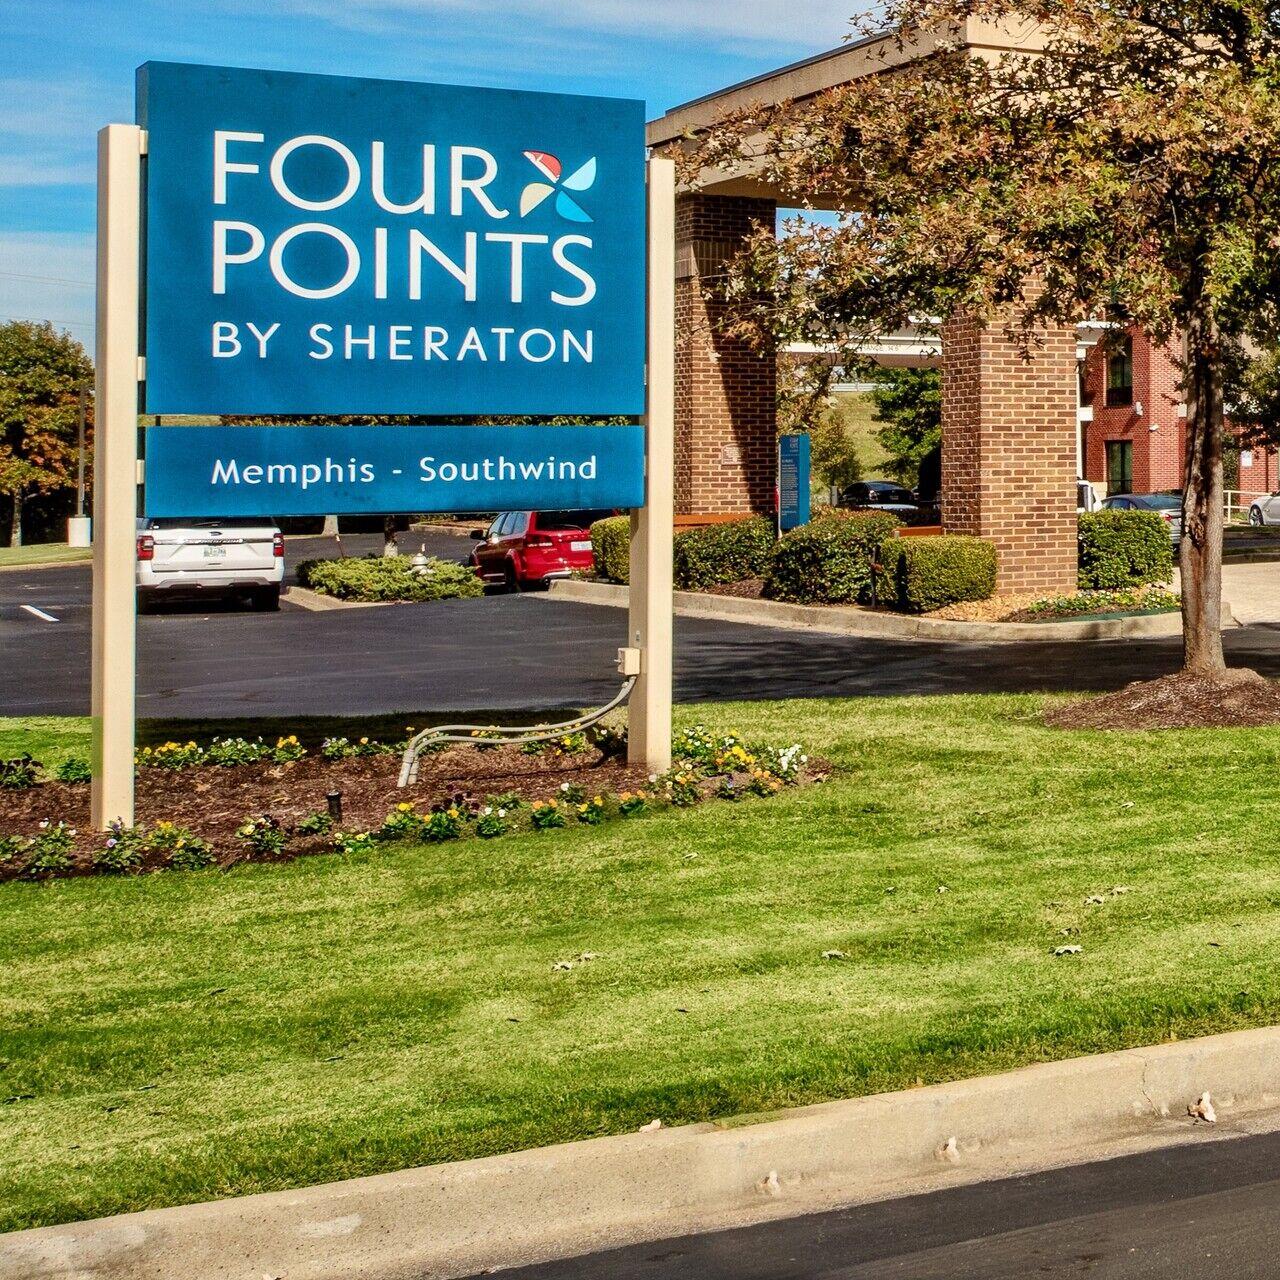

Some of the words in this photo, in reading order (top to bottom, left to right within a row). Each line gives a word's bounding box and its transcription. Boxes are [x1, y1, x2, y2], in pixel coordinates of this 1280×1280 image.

[212, 130, 510, 220] FOUR
[212, 220, 597, 307] POINTS
[211, 321, 281, 359] BY
[308, 323, 594, 363] SHERATON
[210, 457, 375, 490] Memphis
[419, 455, 597, 481] Southwind
